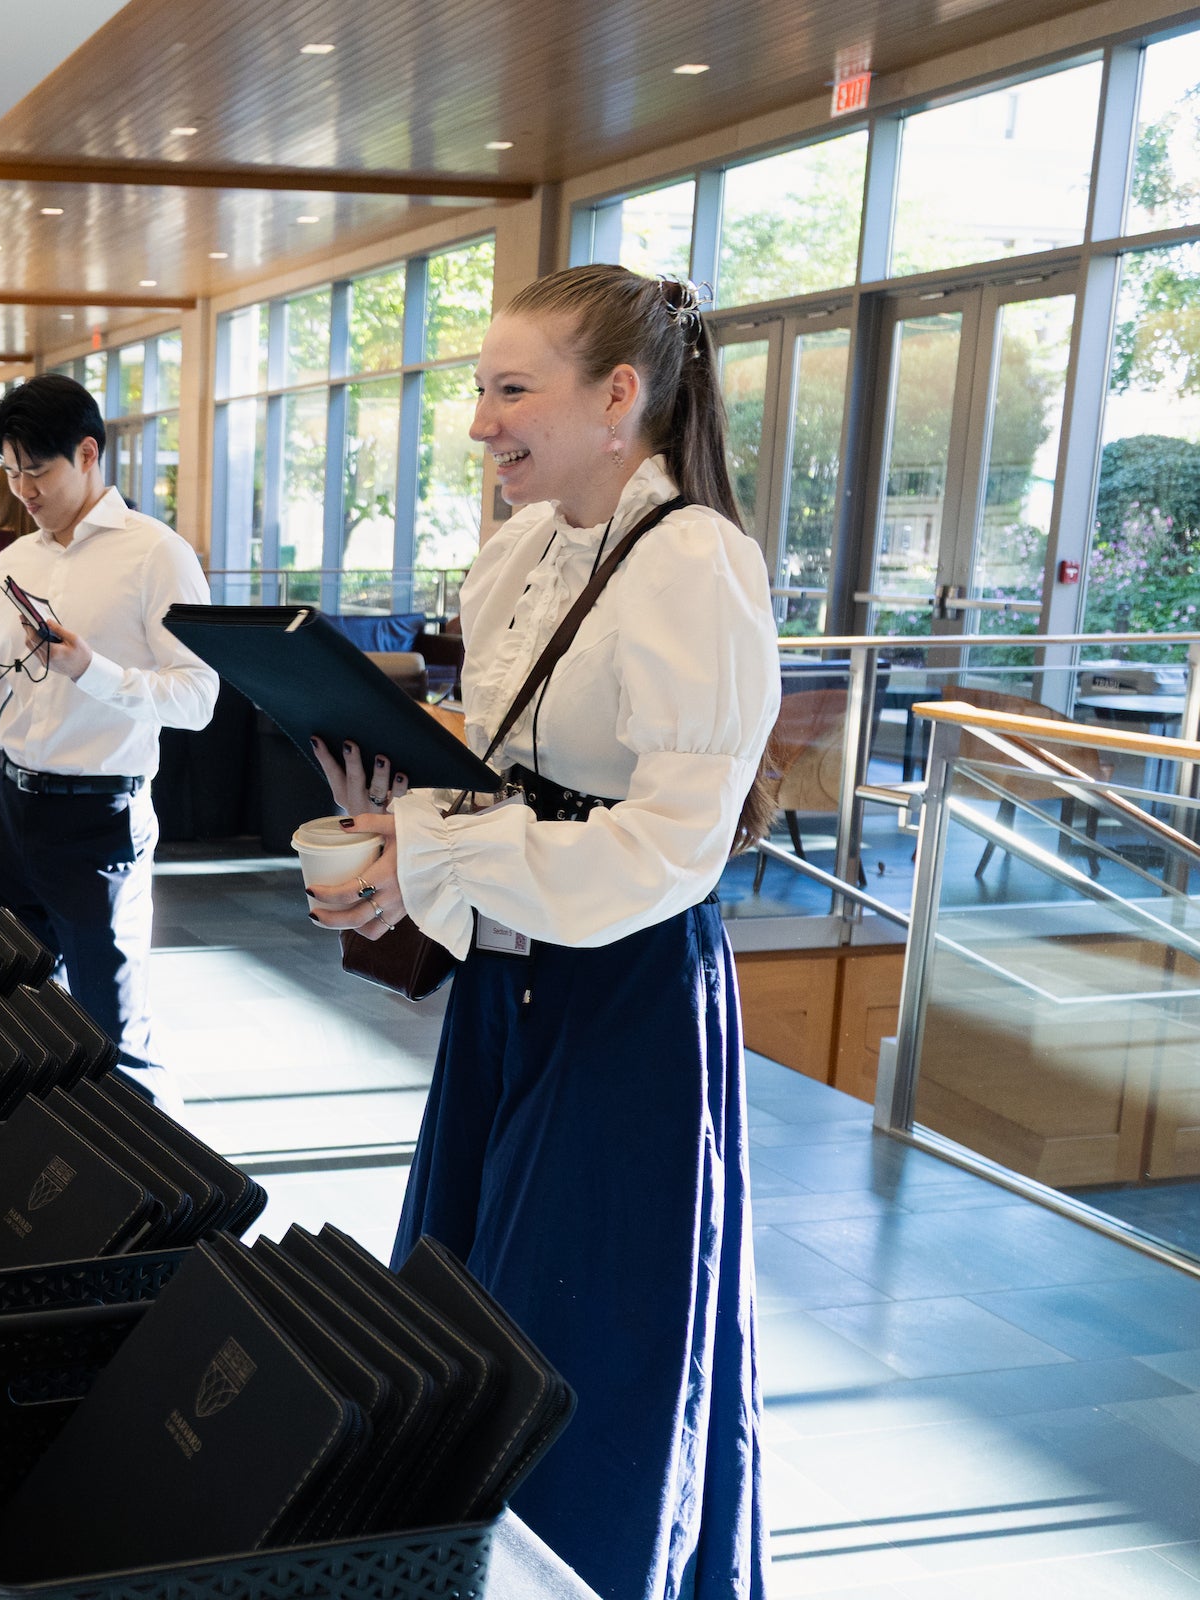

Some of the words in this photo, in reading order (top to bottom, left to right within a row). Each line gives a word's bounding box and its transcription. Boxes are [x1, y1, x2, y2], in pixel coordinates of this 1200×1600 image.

[837, 77, 866, 112] EXIT
[8, 1207, 33, 1233] HARVARD
[170, 1408, 202, 1453] HARVARD
